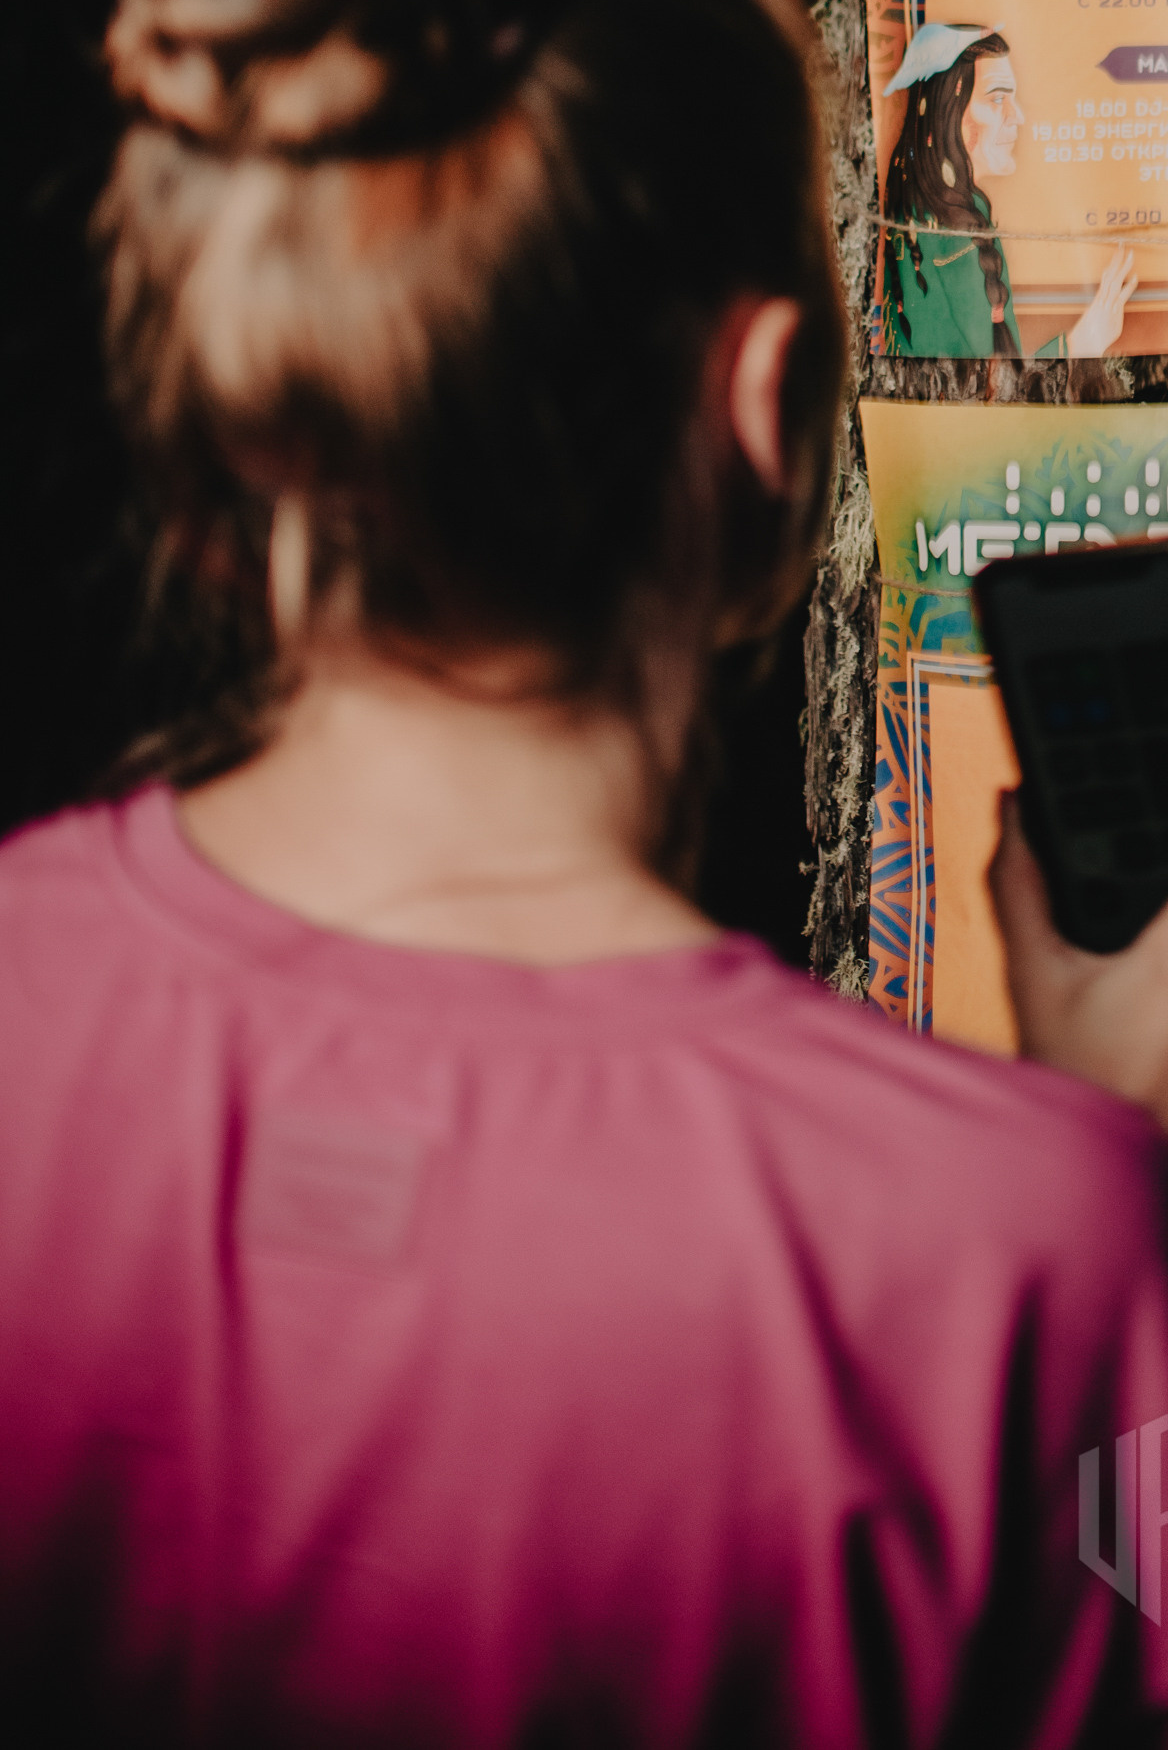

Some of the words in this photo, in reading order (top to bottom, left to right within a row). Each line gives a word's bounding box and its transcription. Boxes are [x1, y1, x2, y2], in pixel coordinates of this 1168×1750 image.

[1076, 100, 1127, 118] 18.00
[1032, 123, 1086, 141] 19.00
[1044, 145, 1103, 163] 20.30
[1106, 211, 1161, 225] 22.00
